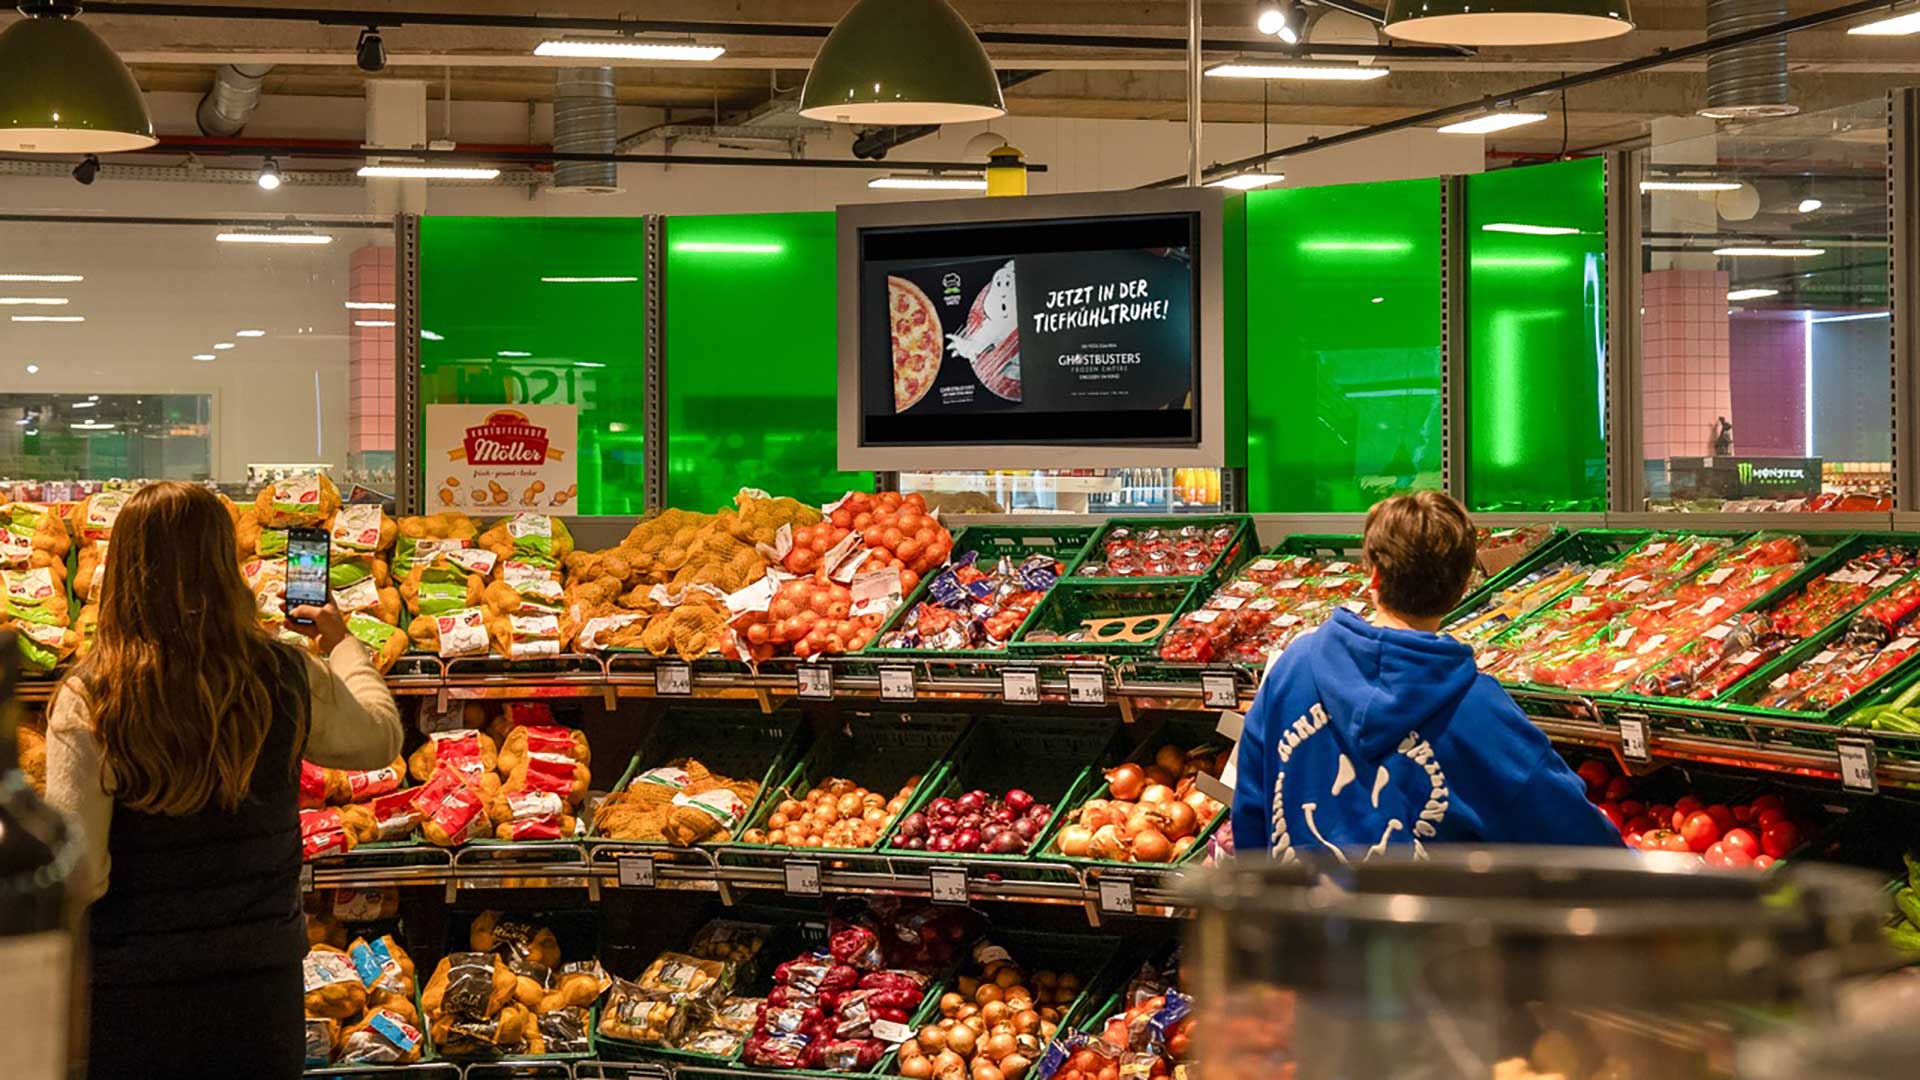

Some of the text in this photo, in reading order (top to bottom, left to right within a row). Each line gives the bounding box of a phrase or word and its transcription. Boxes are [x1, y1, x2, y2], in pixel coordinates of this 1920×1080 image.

[1046, 279, 1148, 309] JETZT IN DER
[1033, 300, 1169, 333] TIEFKÜHLTRUHE!
[474, 438, 542, 461] Möller
[1753, 468, 1804, 479] MONSTER
